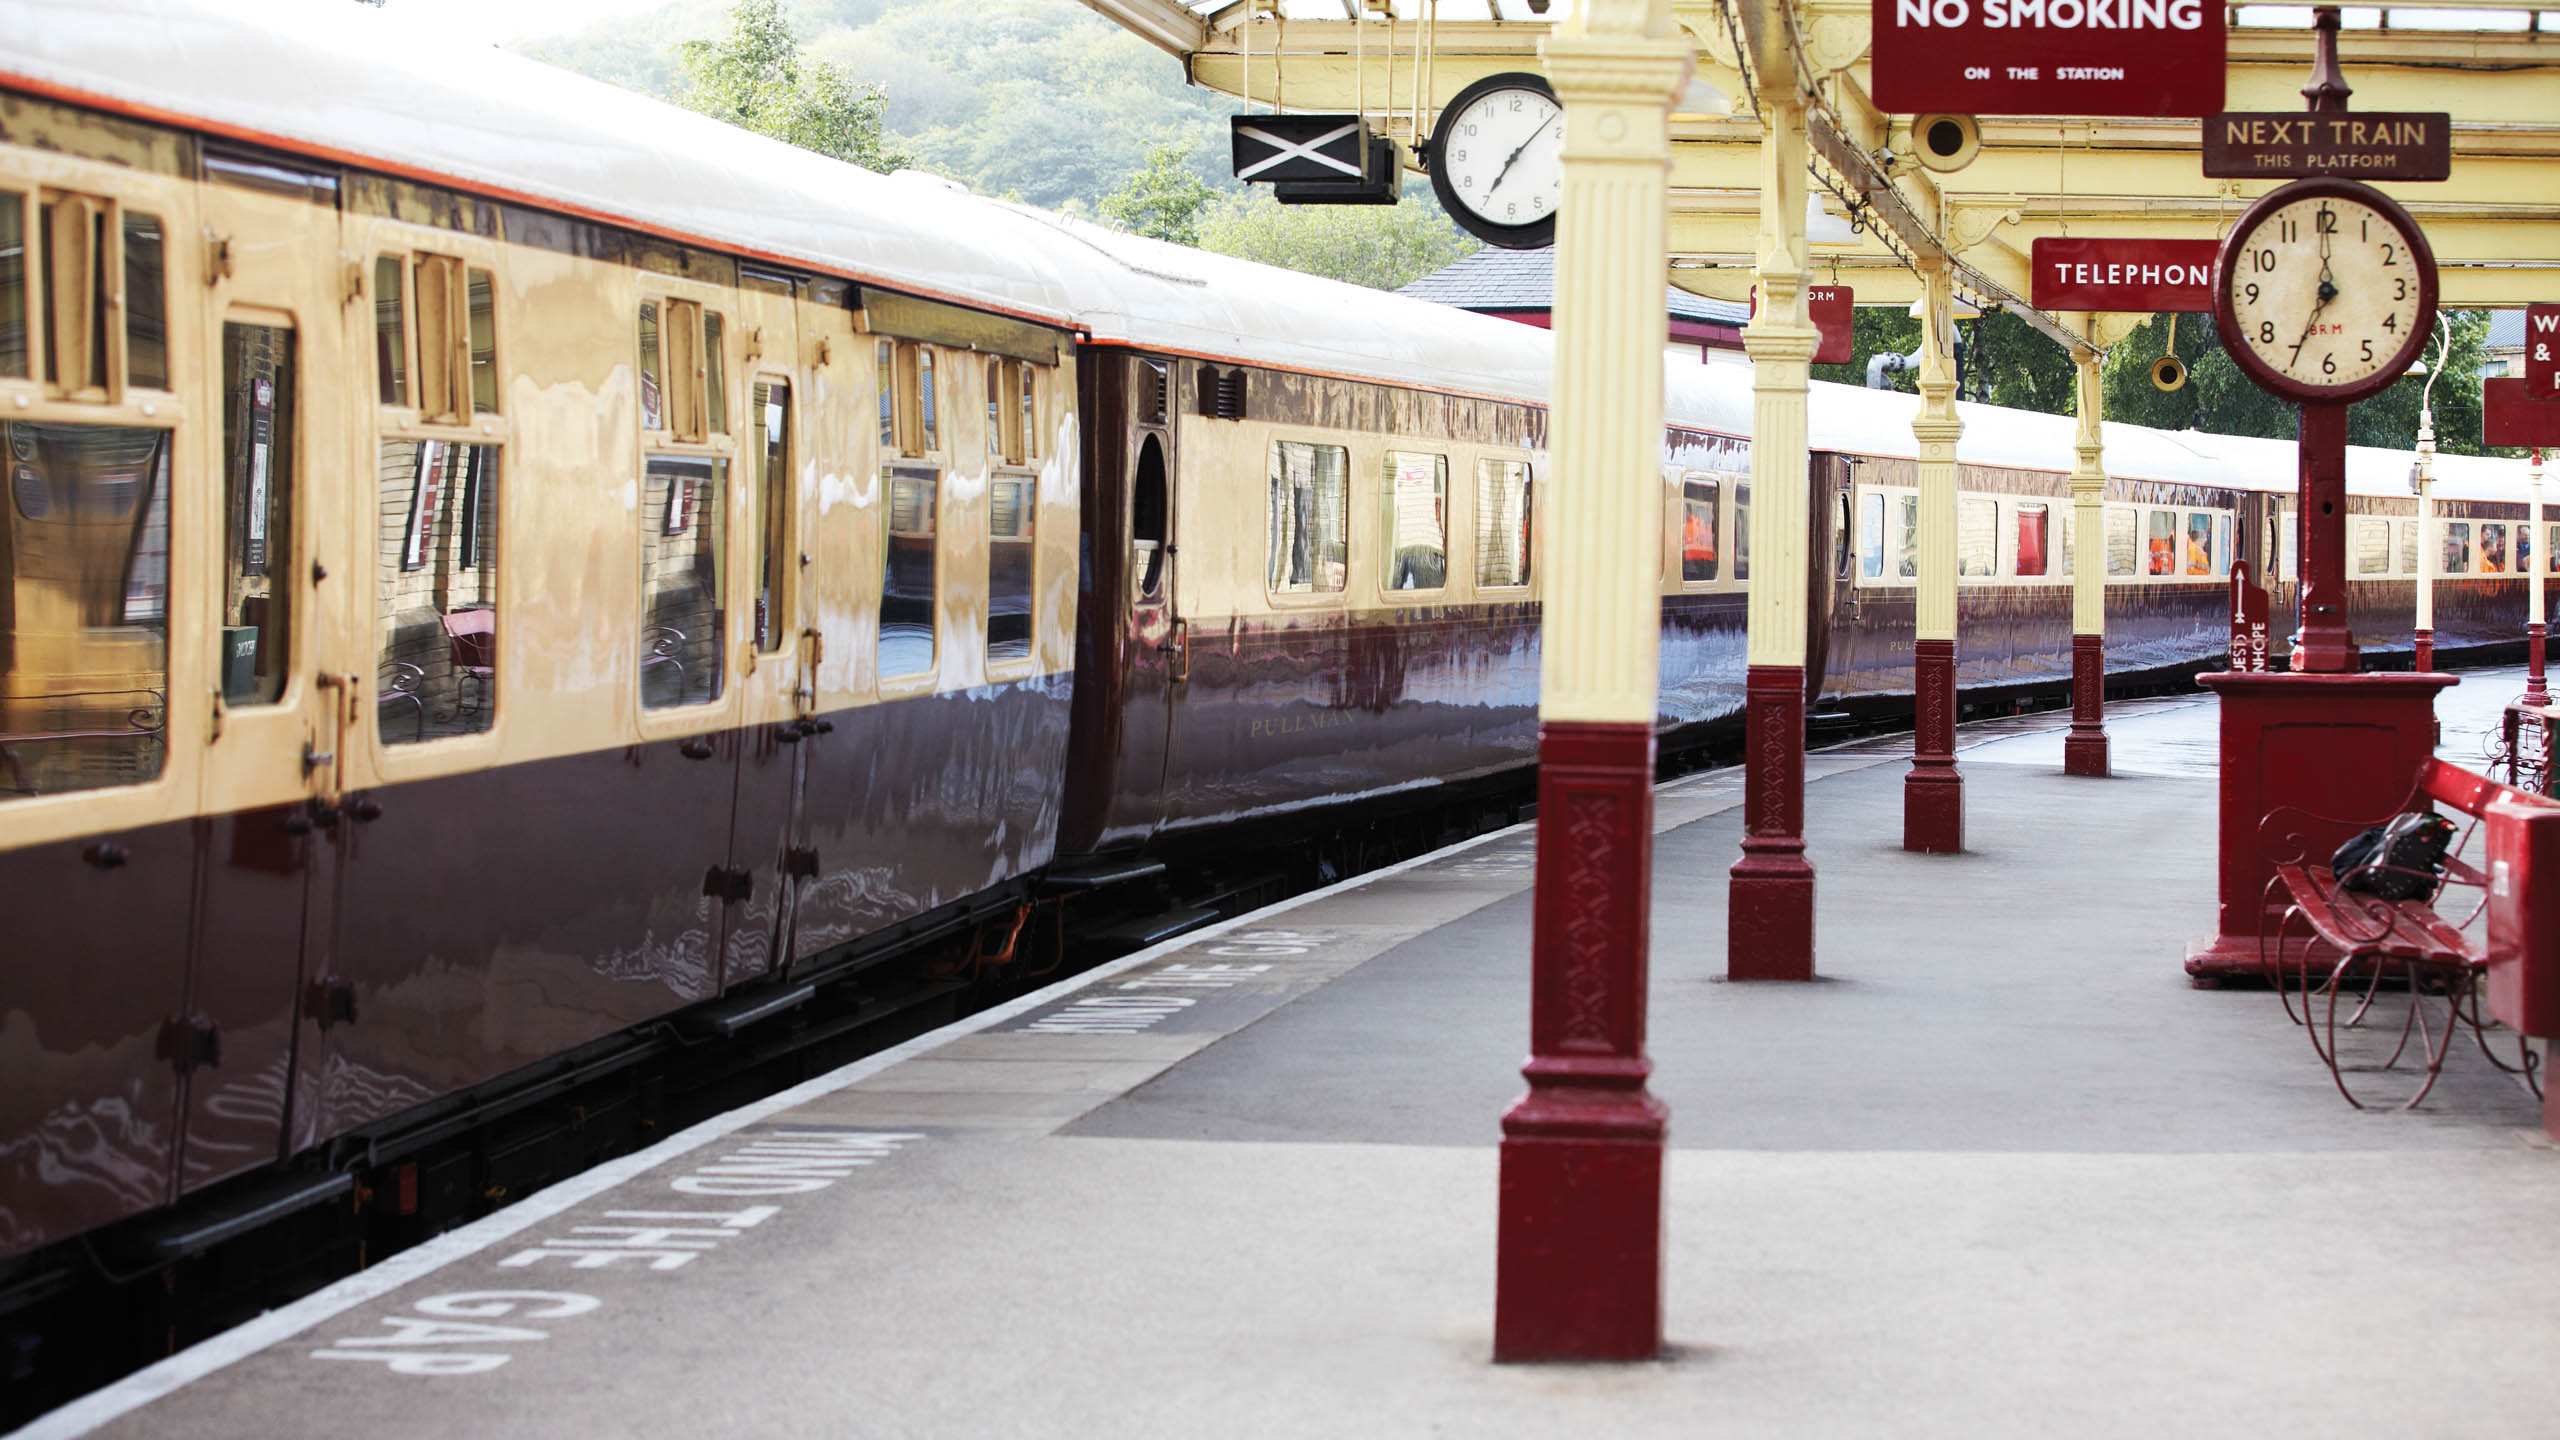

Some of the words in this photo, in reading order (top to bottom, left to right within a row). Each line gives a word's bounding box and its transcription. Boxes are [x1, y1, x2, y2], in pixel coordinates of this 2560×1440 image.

[1897, 0, 1970, 27] NO
[1983, 0, 2202, 29] SMOKING
[1964, 67, 1990, 79] ON
[2006, 68, 2039, 79] THE
[2056, 67, 2124, 80] STATION
[1485, 106, 1494, 118] 11
[1510, 101, 1522, 112] 12
[1464, 124, 1477, 136] 10
[2227, 121, 2315, 144] NEXT
[2329, 122, 2425, 145] TRAIN
[1458, 150, 1466, 161] 9
[2254, 154, 2291, 168] THIS
[2307, 154, 2396, 168] PLATFORM
[1464, 176, 1472, 187] 8
[1483, 195, 1490, 206] 7
[1508, 203, 1515, 215] 6
[1534, 197, 1542, 208] 5
[2282, 220, 2295, 243] 11
[2316, 210, 2338, 233] 12
[2253, 249, 2275, 272] 10
[2381, 243, 2397, 266] 2
[2246, 283, 2259, 305] 9
[2393, 278, 2406, 301] 3
[2261, 320, 2275, 343] 8
[2382, 312, 2396, 334] 4
[2533, 315, 2560, 333] W
[2288, 344, 2301, 367] 7
[2361, 339, 2373, 362] 5
[2534, 343, 2551, 361] &
[2322, 352, 2336, 374] 6
[1250, 708, 1354, 738] PULLMAN
[1014, 996, 1198, 1034] MIND
[1118, 963, 1272, 989] THE
[1208, 931, 1338, 957] GAP
[671, 1131, 927, 1196] MIND
[498, 1206, 782, 1270] THE
[309, 1289, 602, 1376] GAP
